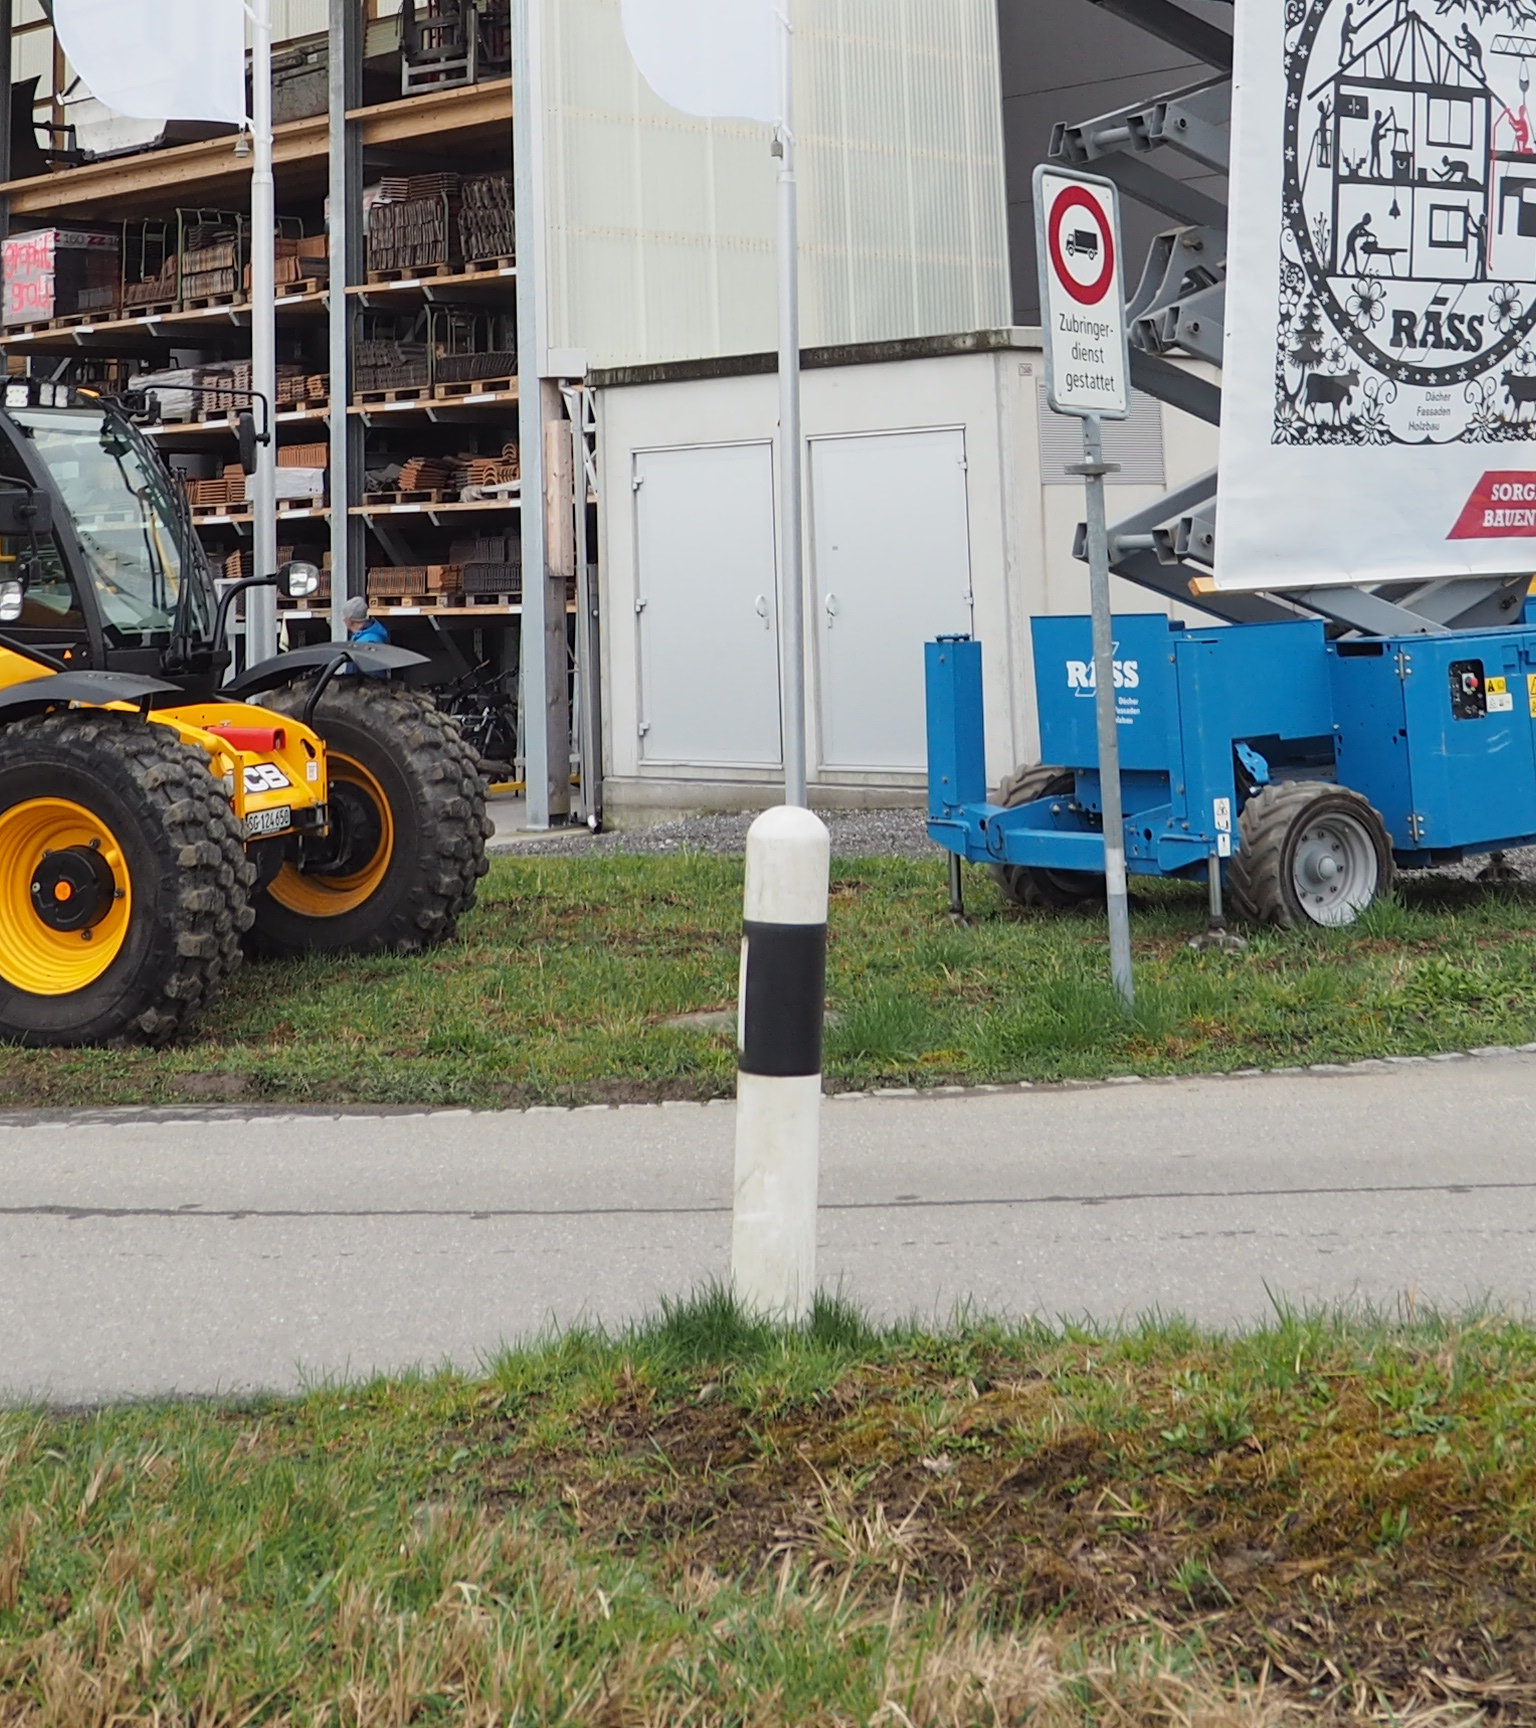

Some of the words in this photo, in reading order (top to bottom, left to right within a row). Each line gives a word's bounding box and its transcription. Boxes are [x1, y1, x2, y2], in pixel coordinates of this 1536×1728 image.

[1059, 312, 1114, 339] Zubringer-
[1071, 342, 1104, 364] dienst
[1065, 370, 1116, 393] gestattet
[1425, 391, 1452, 402] Dächer
[1416, 406, 1452, 417] Fassaden
[1407, 420, 1440, 431] Holzbau
[243, 763, 290, 793] CB
